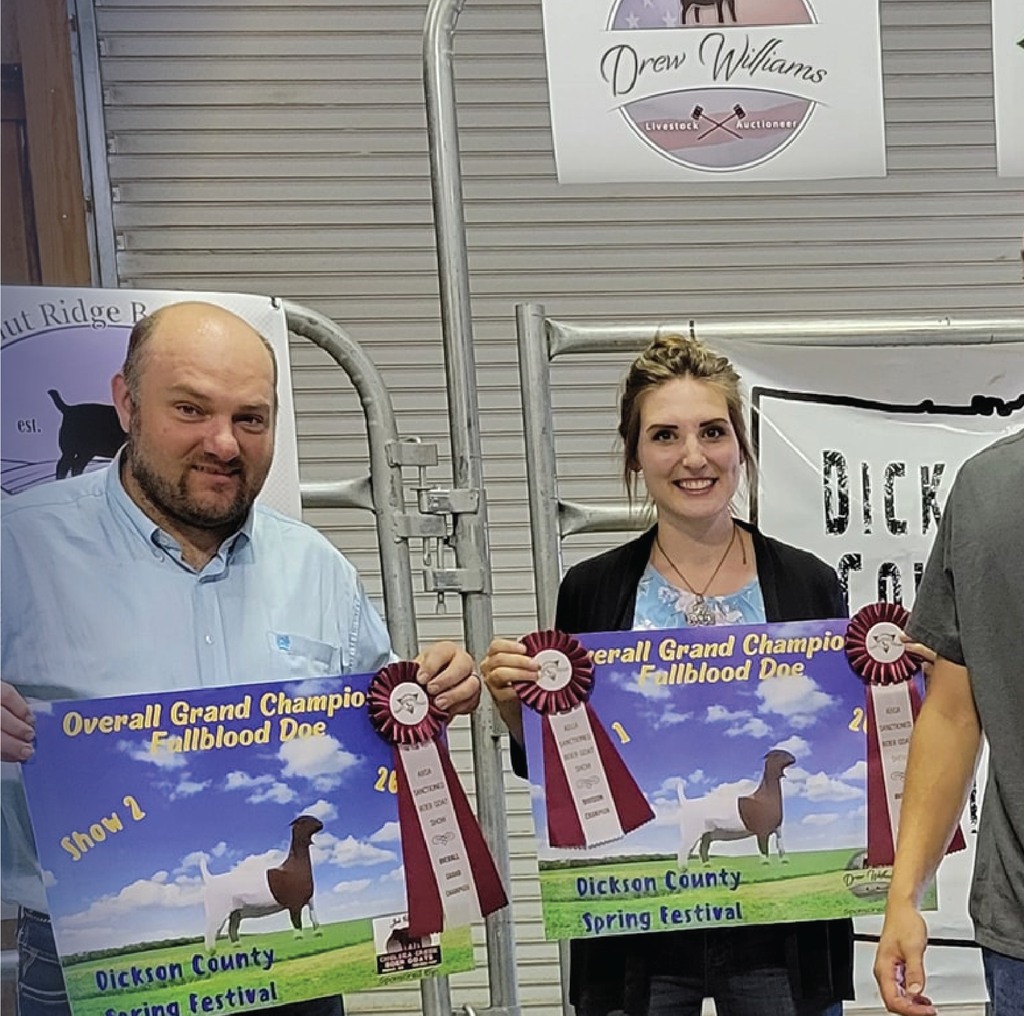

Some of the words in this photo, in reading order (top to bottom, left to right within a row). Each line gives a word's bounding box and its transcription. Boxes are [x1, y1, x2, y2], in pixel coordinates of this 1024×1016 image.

[601, 42, 686, 97] Drew
[698, 32, 828, 84] Williams
[645, 121, 699, 132] Livestock
[736, 118, 797, 130] Auctioneer
[40, 298, 121, 330] Ridge
[822, 449, 946, 536] DICK
[658, 635, 735, 662] Grand
[638, 660, 751, 687] Fullblood
[758, 657, 806, 680] Doe
[62, 703, 163, 737] Overall
[170, 695, 251, 727] Grand
[149, 724, 271, 754] Fullblood
[278, 719, 327, 743] Doe
[60, 811, 124, 861] Show
[122, 794, 147, 822] 2
[576, 876, 657, 897] Dickson
[665, 868, 742, 892] County
[582, 909, 651, 935] Spring
[659, 901, 743, 925] Festival
[95, 962, 182, 991] Dickson
[191, 946, 275, 971] County
[188, 980, 278, 1014] Festival
